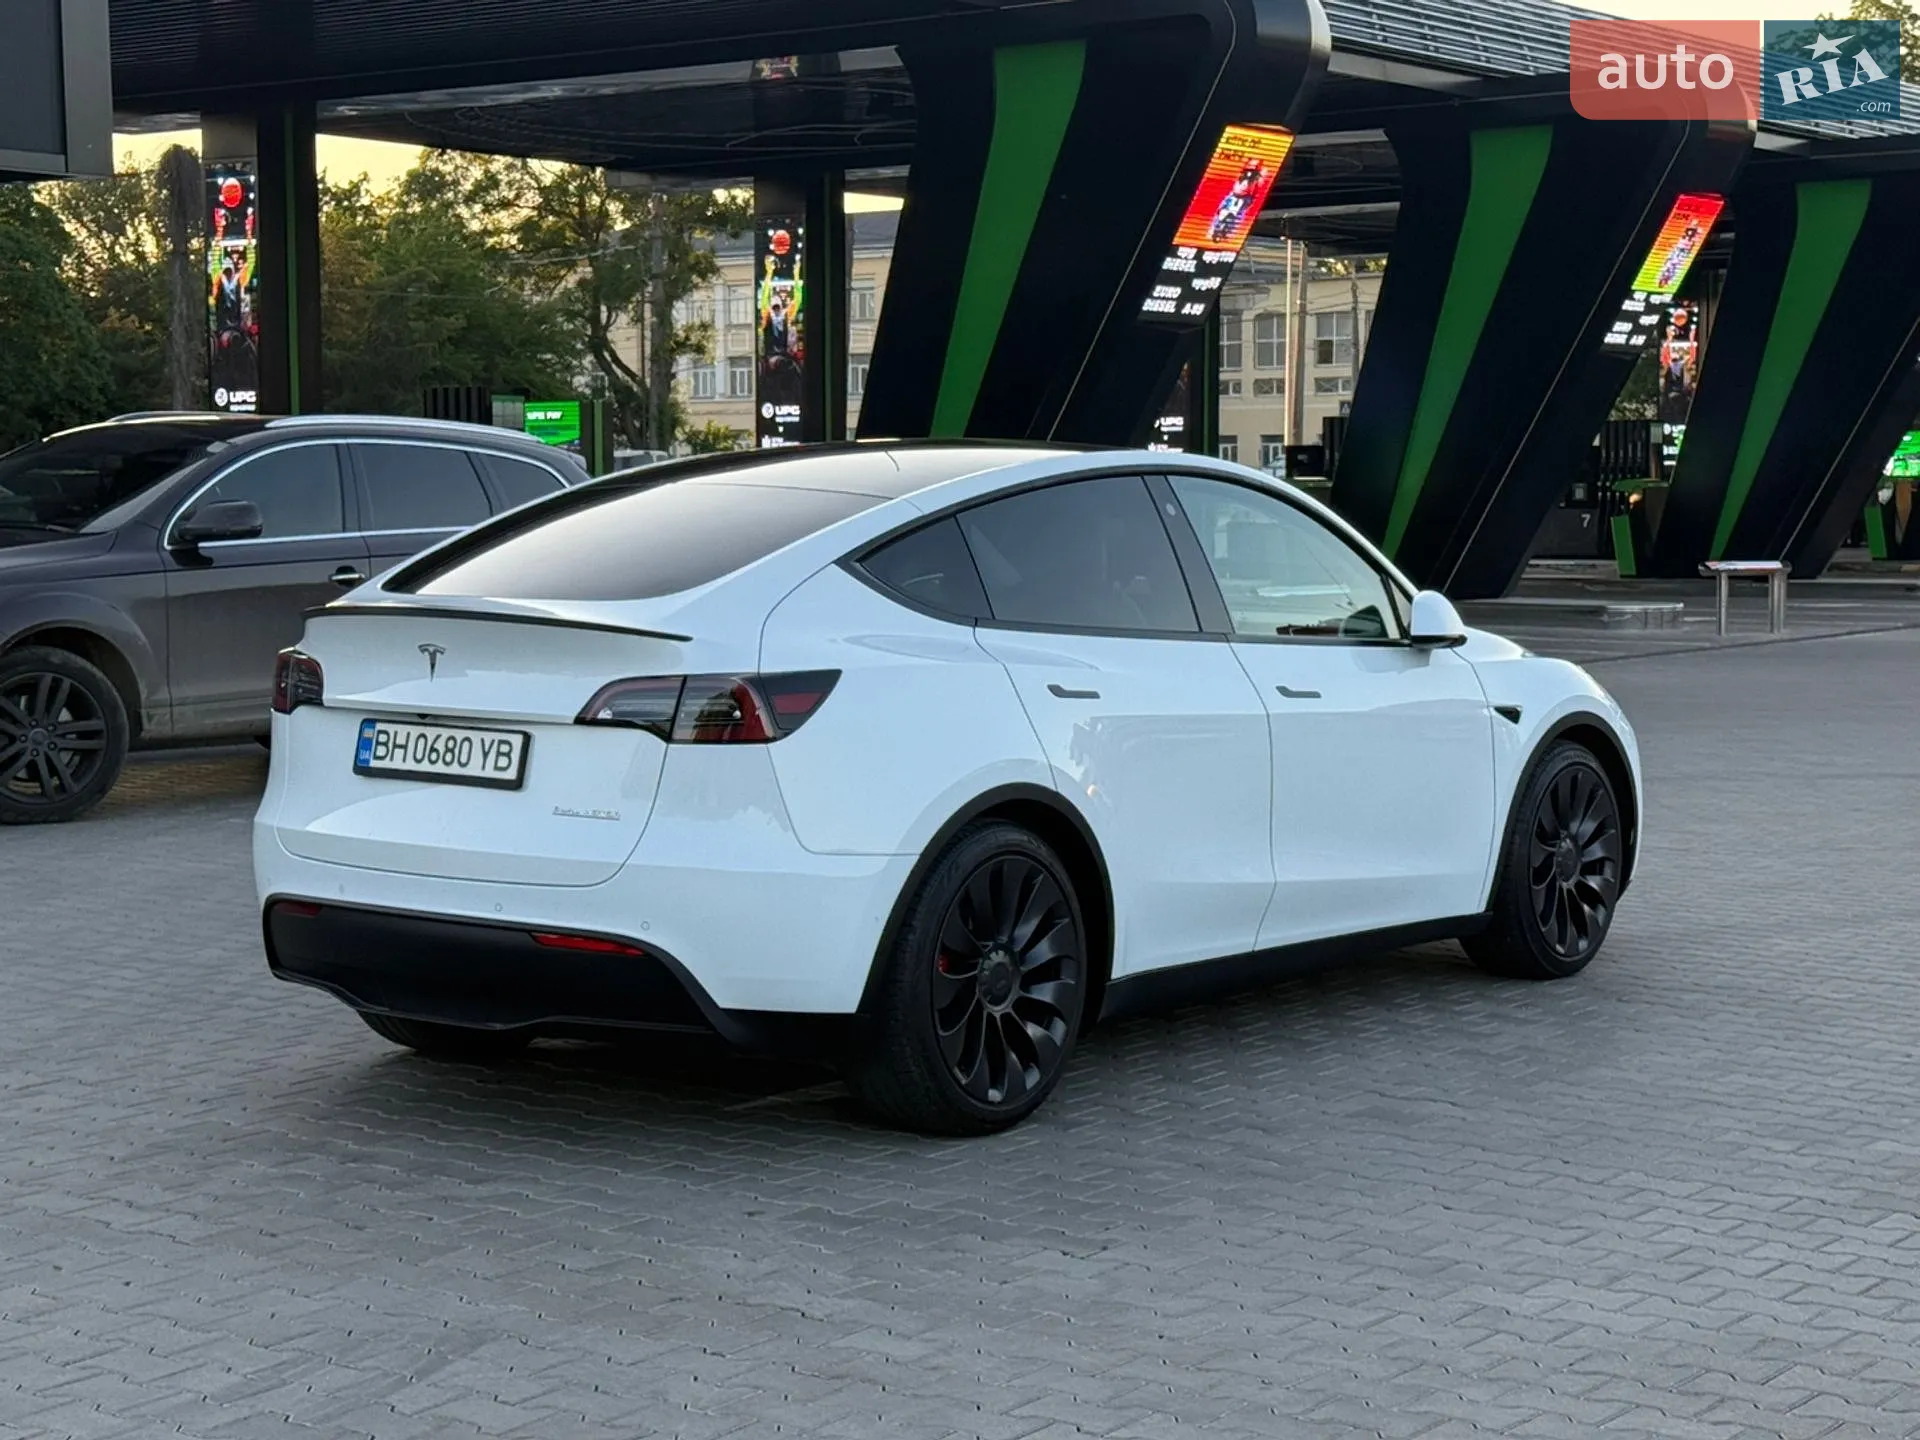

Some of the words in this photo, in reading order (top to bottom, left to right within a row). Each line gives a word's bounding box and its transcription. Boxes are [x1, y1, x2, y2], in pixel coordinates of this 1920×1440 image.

[229, 391, 256, 403] UPG
[1581, 513, 1591, 528] 7
[480, 737, 514, 772] YB
